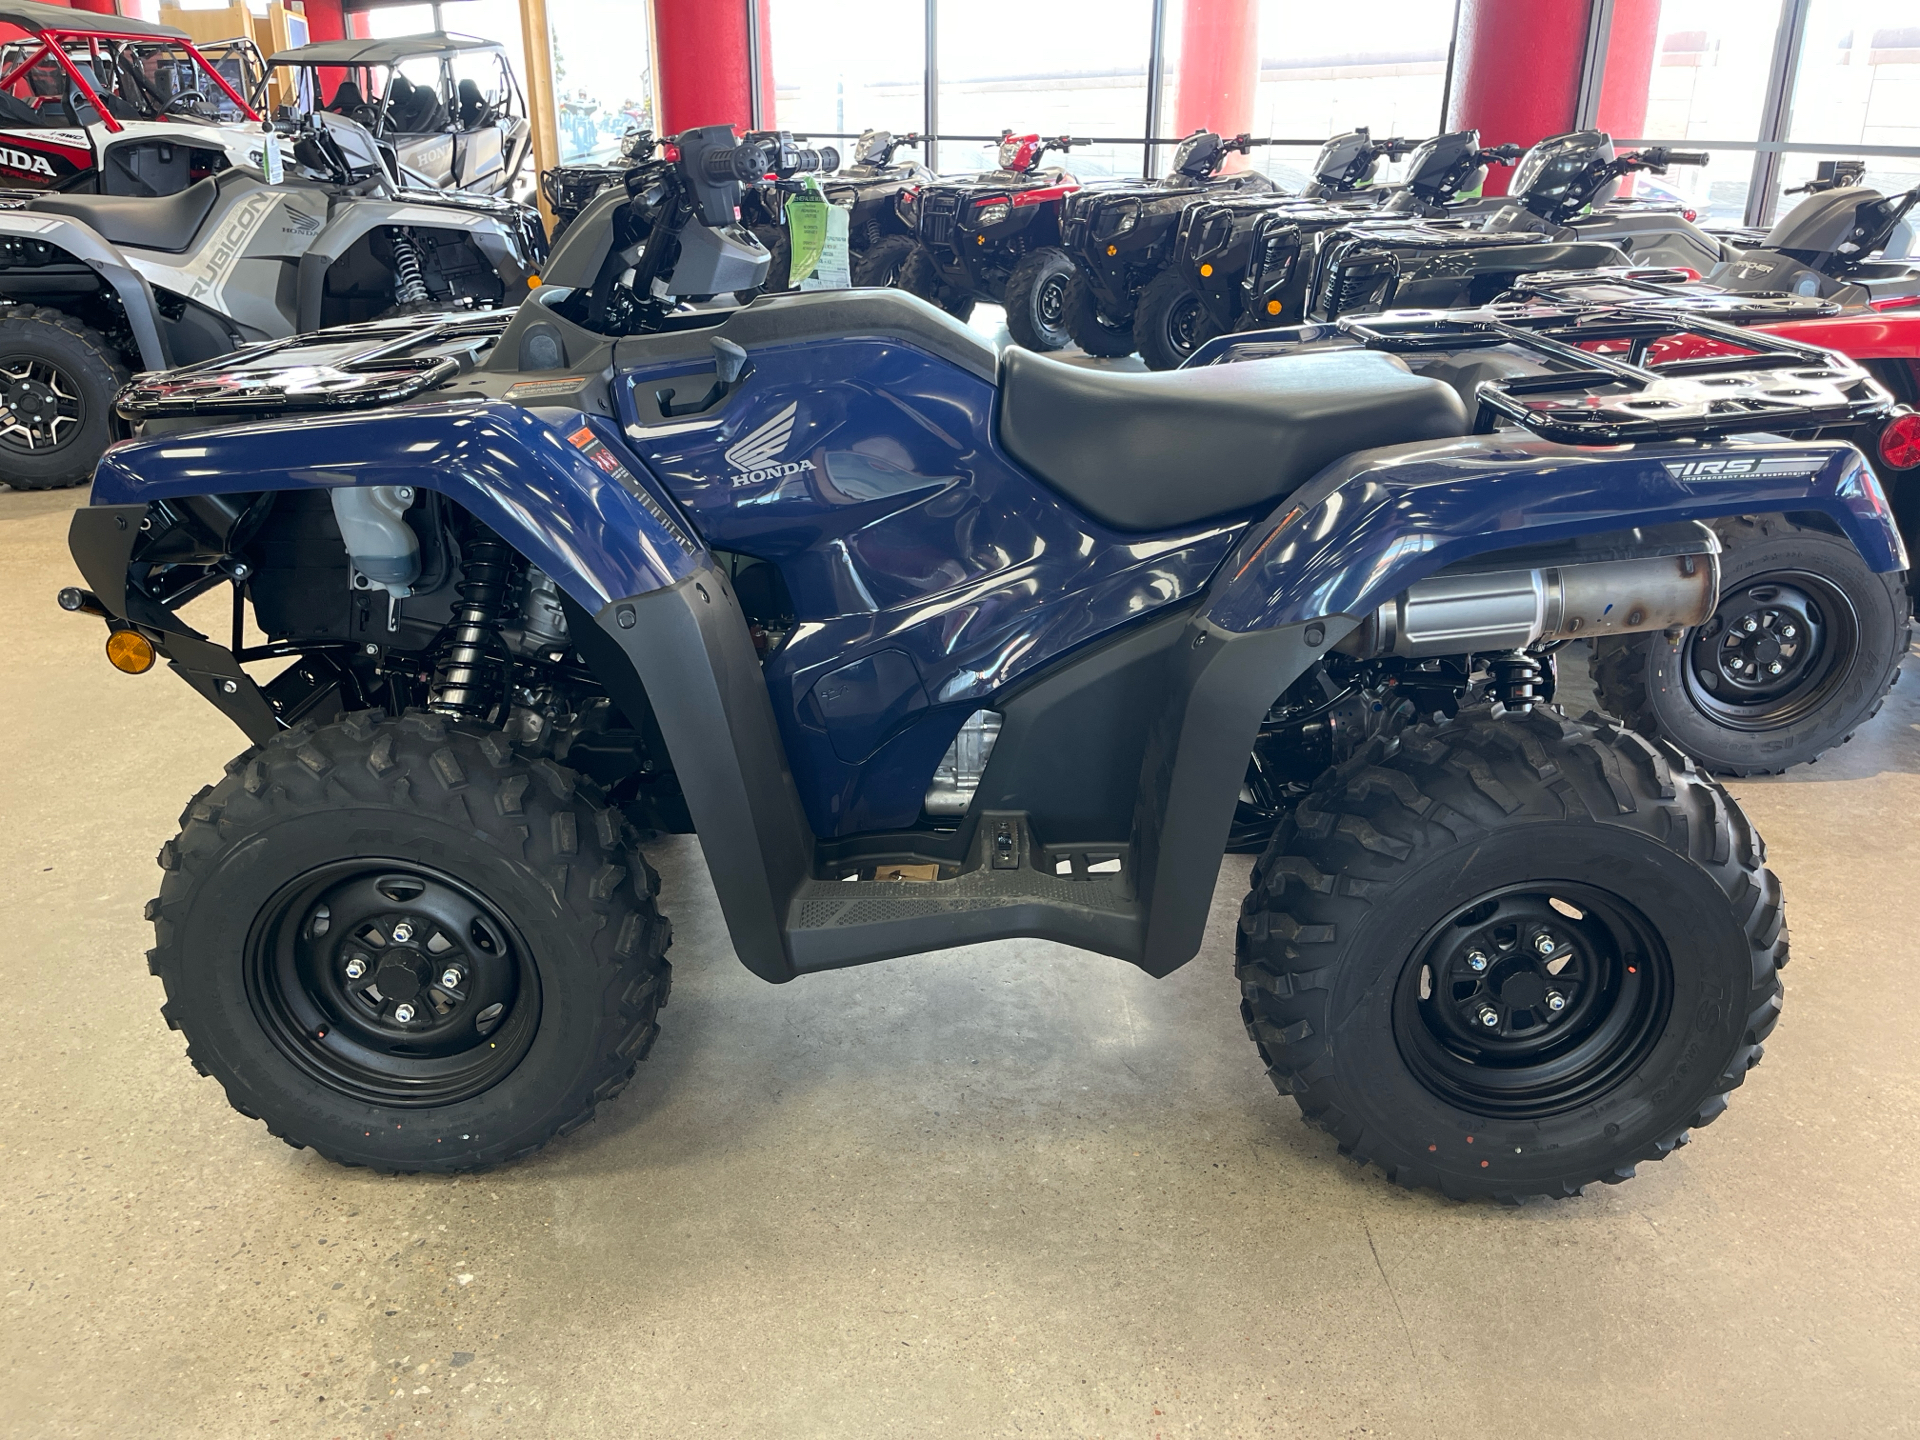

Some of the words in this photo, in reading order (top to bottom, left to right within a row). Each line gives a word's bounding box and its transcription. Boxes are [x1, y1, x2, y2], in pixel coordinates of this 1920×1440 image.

[0, 147, 57, 177] NDA
[187, 191, 270, 298] RUBICON
[282, 227, 319, 237] HONDA
[730, 459, 817, 488] HONDA
[1682, 459, 1756, 476] IRS
